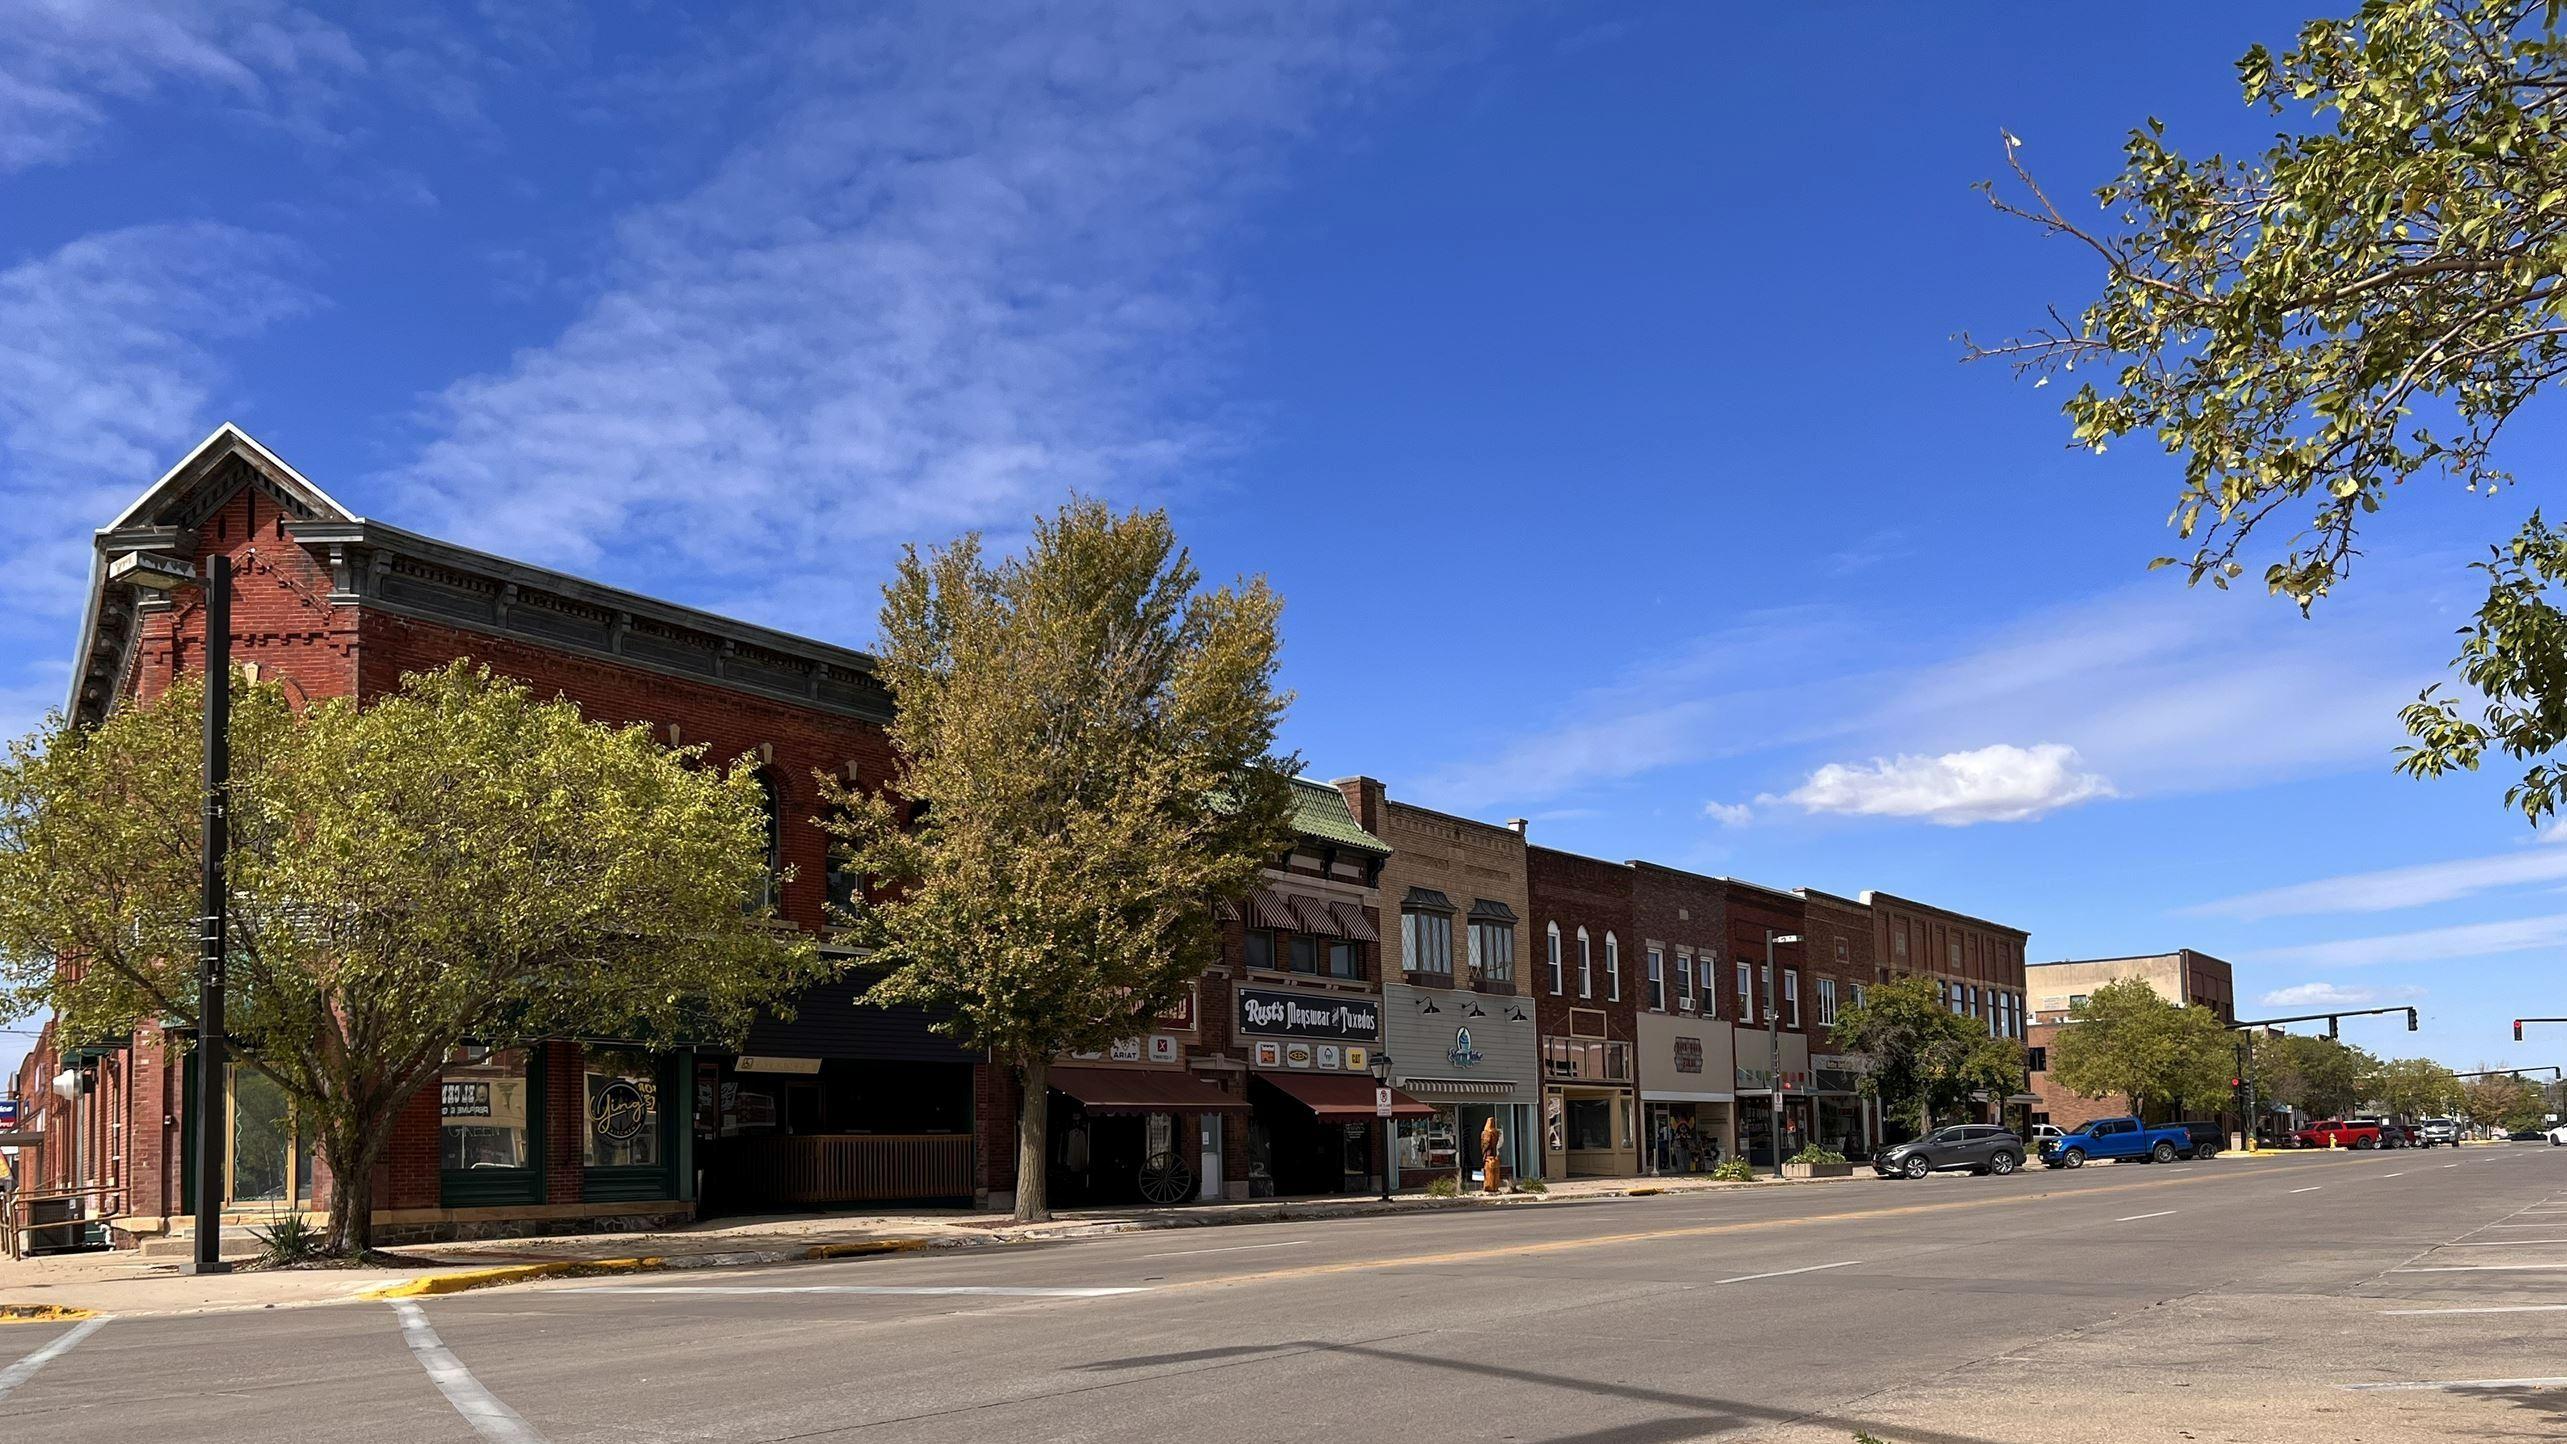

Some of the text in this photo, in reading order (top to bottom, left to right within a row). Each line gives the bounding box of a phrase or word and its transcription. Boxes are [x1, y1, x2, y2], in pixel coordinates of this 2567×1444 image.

[1244, 998, 1285, 1026] Rust's
[1286, 1001, 1331, 1030] Menswear
[1340, 1006, 1376, 1034] Tuxedos
[1113, 1051, 1137, 1060] ARIAT
[1289, 1051, 1308, 1061] KEEN
[1351, 1053, 1361, 1064] CAT
